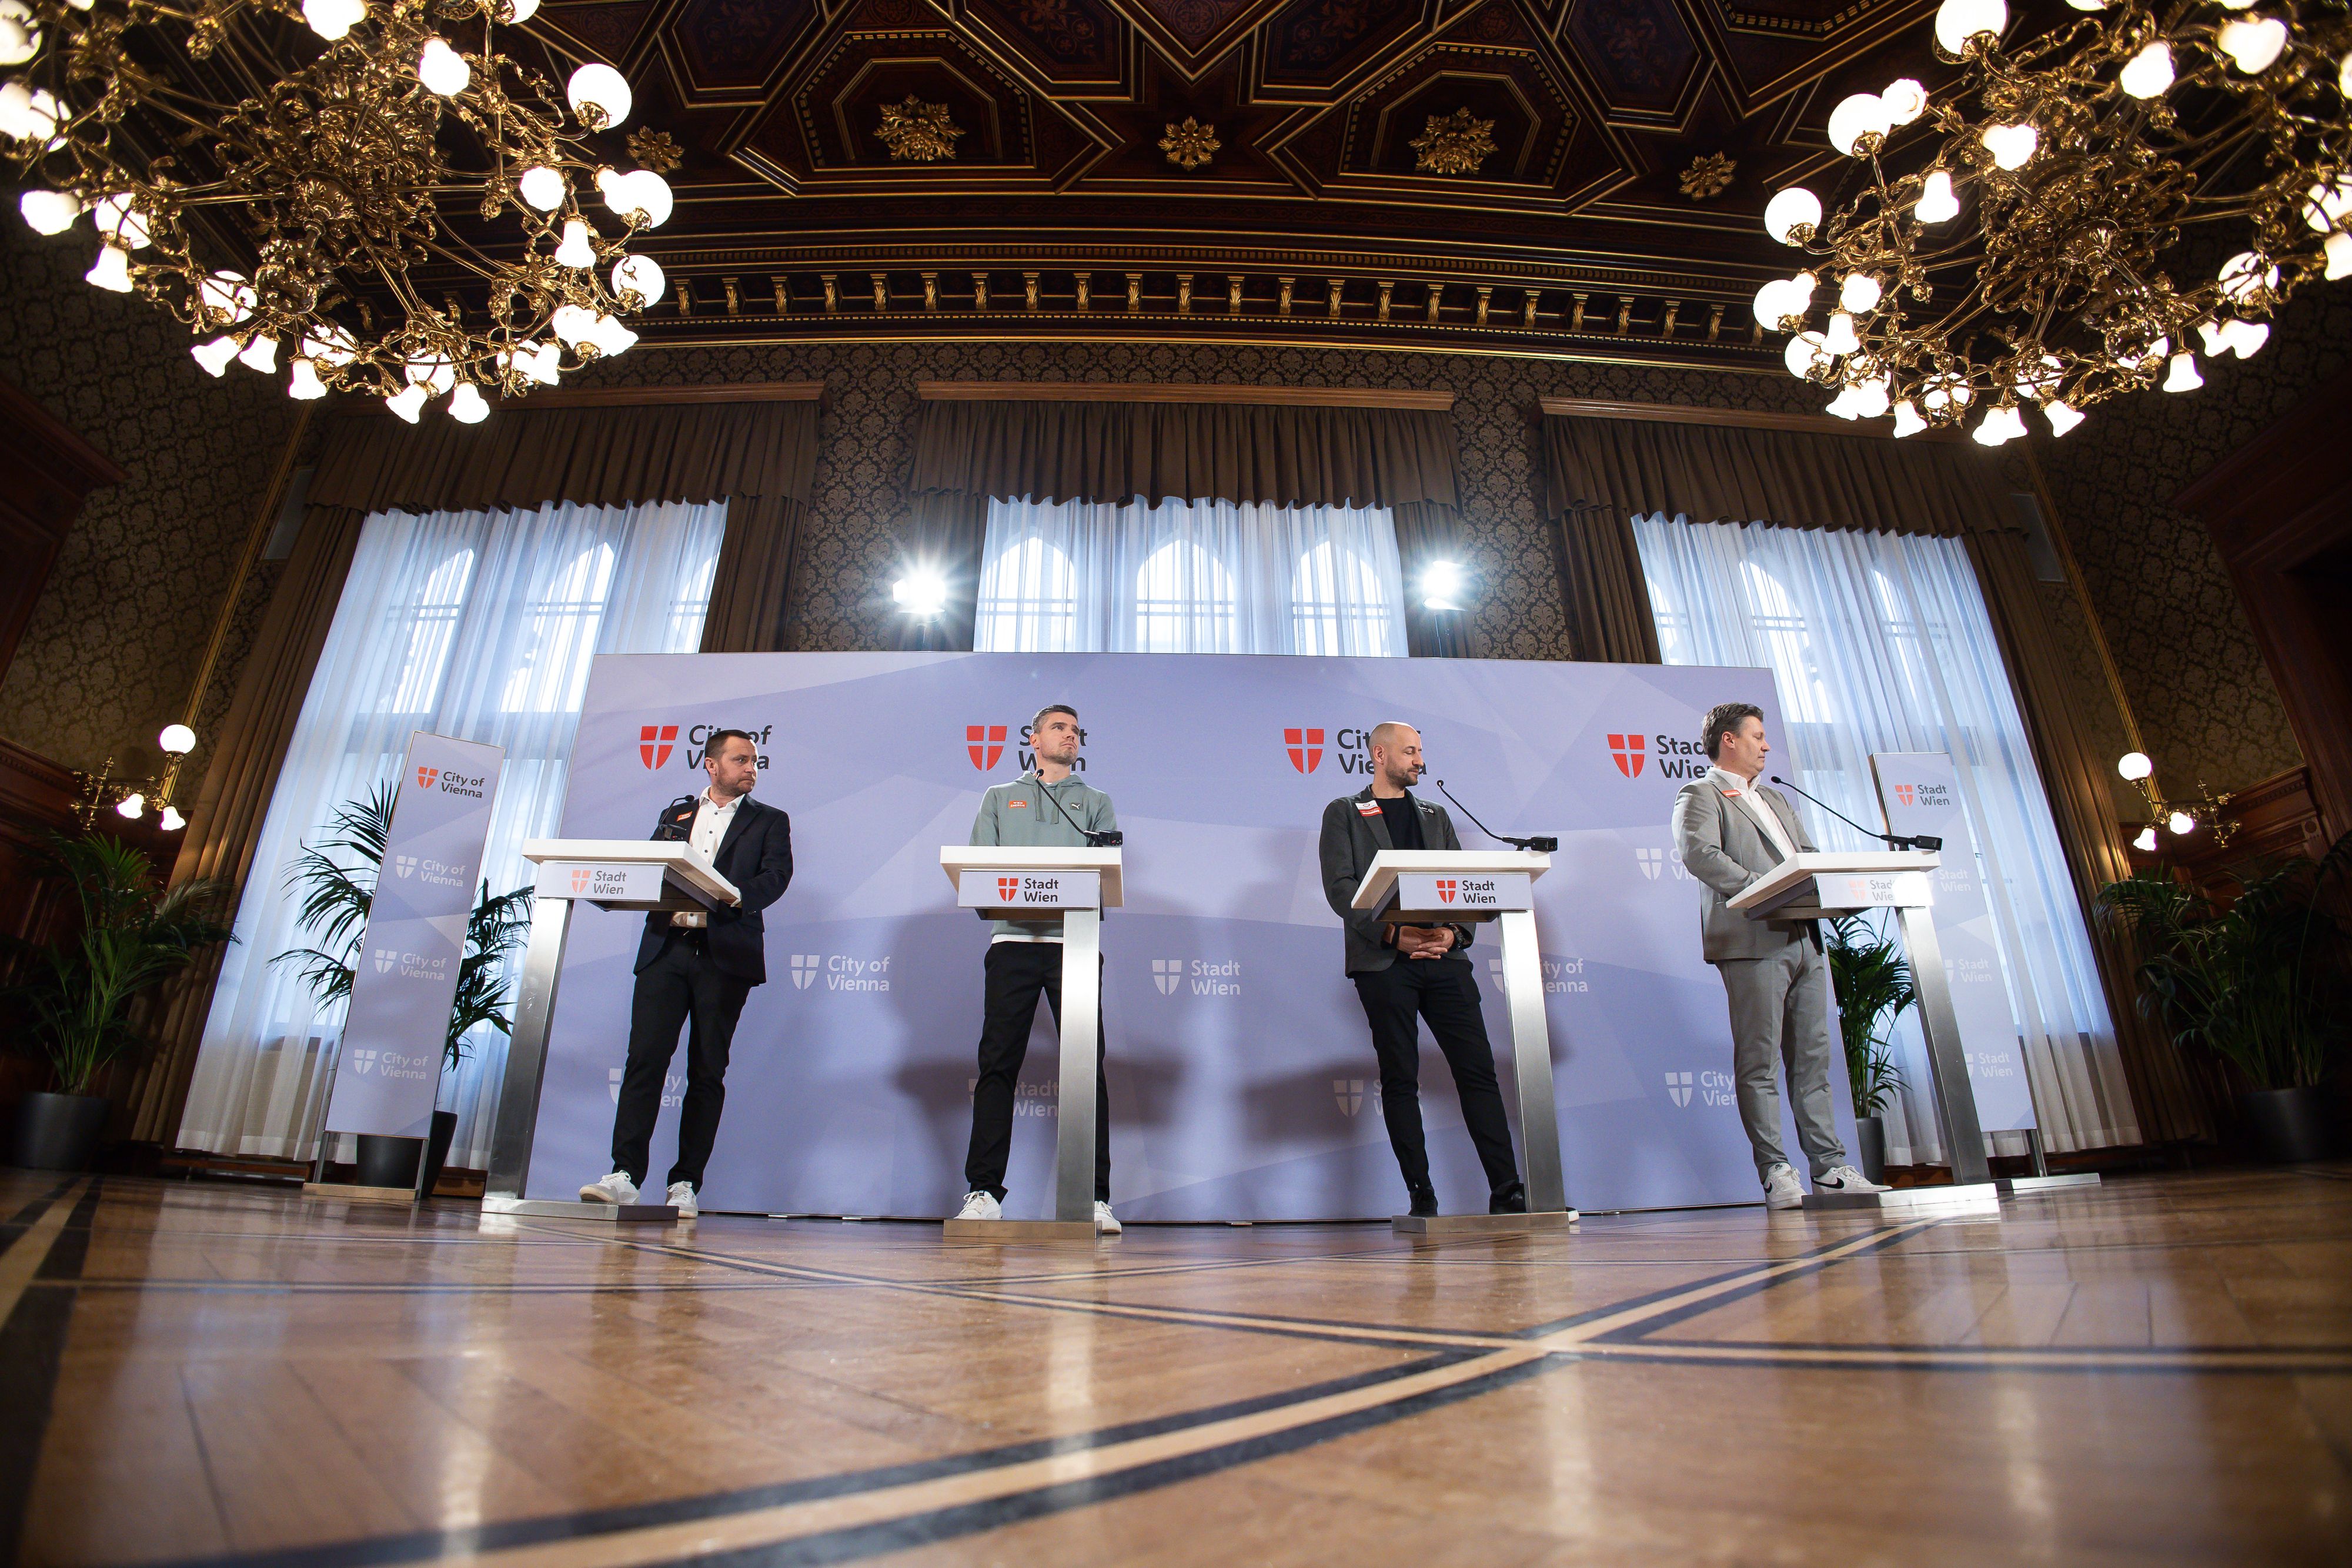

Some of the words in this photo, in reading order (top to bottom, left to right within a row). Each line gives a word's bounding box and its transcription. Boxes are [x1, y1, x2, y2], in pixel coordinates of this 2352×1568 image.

[1337, 728, 1371, 749] Cit
[1656, 734, 1708, 755] Stad
[1659, 758, 1713, 778] Wie
[443, 771, 468, 786] City
[470, 778, 485, 787] of
[441, 782, 482, 798] Vienna
[1917, 784, 1947, 794] Stadt
[1920, 796, 1950, 805] Wien
[422, 860, 449, 875] City
[451, 865, 466, 875] of
[1939, 869, 1969, 880] Stadt
[420, 871, 463, 887] Vienna
[595, 870, 627, 882] Stadt
[594, 883, 624, 894] Wien
[1024, 878, 1059, 889] Stadt
[1462, 880, 1495, 891] Stadt
[1870, 880, 1894, 890] Stad
[1940, 881, 1971, 892] Wien
[1024, 891, 1058, 902] Wien
[1463, 892, 1496, 903] Wien
[1872, 891, 1894, 901] Wie
[402, 953, 429, 968] City
[432, 958, 447, 968] of
[828, 955, 865, 976] City
[870, 956, 890, 972] of
[1191, 959, 1241, 976] Stadt
[1565, 958, 1583, 974] of
[1959, 958, 1989, 969] Stadt
[400, 965, 445, 981] Vienna
[1960, 971, 1992, 982] Wien
[827, 974, 890, 991] Vienna
[1191, 979, 1241, 995] Wien
[382, 1052, 410, 1068] City
[413, 1056, 429, 1066] of
[1979, 1051, 2010, 1064] Stadt
[380, 1065, 427, 1079] Vienna
[1980, 1065, 2013, 1077] Wien
[1700, 1071, 1734, 1091] City
